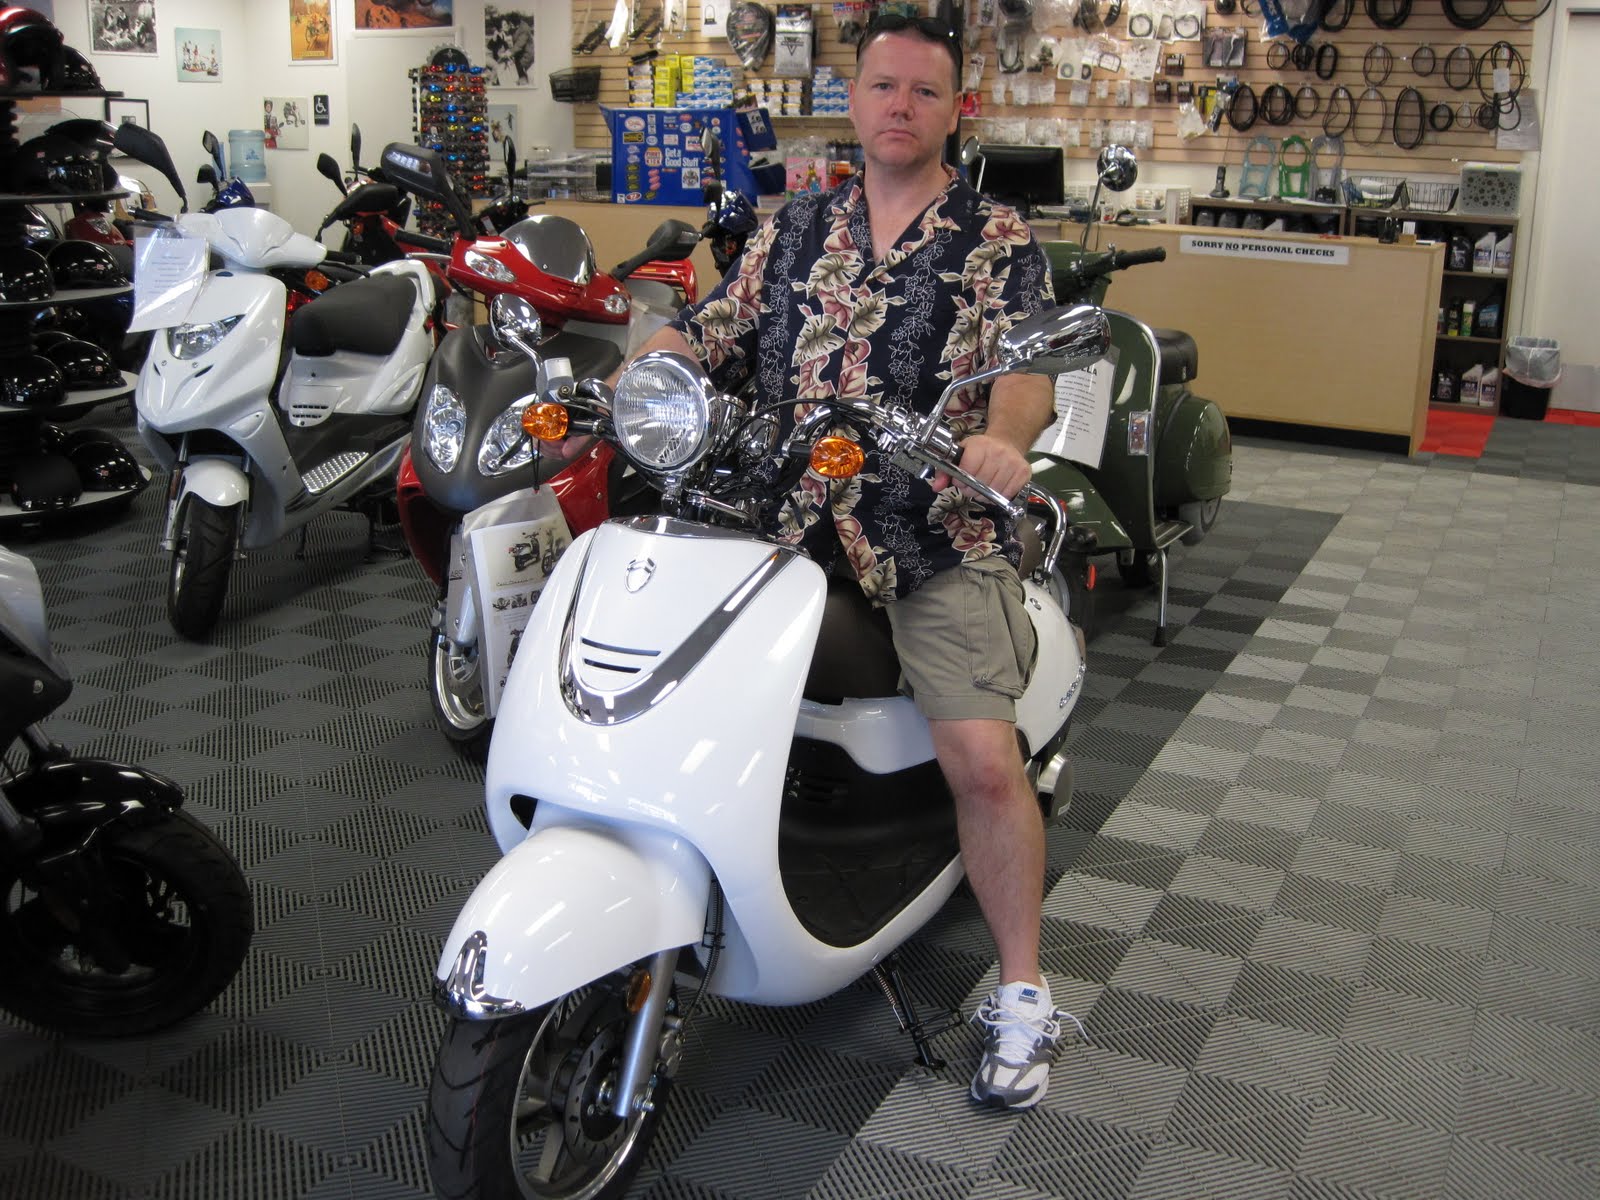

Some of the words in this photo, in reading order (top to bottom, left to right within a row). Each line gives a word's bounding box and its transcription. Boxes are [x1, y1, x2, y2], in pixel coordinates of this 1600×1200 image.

[665, 147, 676, 157] Get
[665, 157, 681, 167] Good
[682, 157, 698, 166] Stuff
[1192, 240, 1223, 250] SORRY
[1225, 243, 1240, 251] NO
[1241, 243, 1293, 254] PERSONAL
[1295, 247, 1335, 257] CHECKS
[1021, 988, 1038, 997] NIKE
